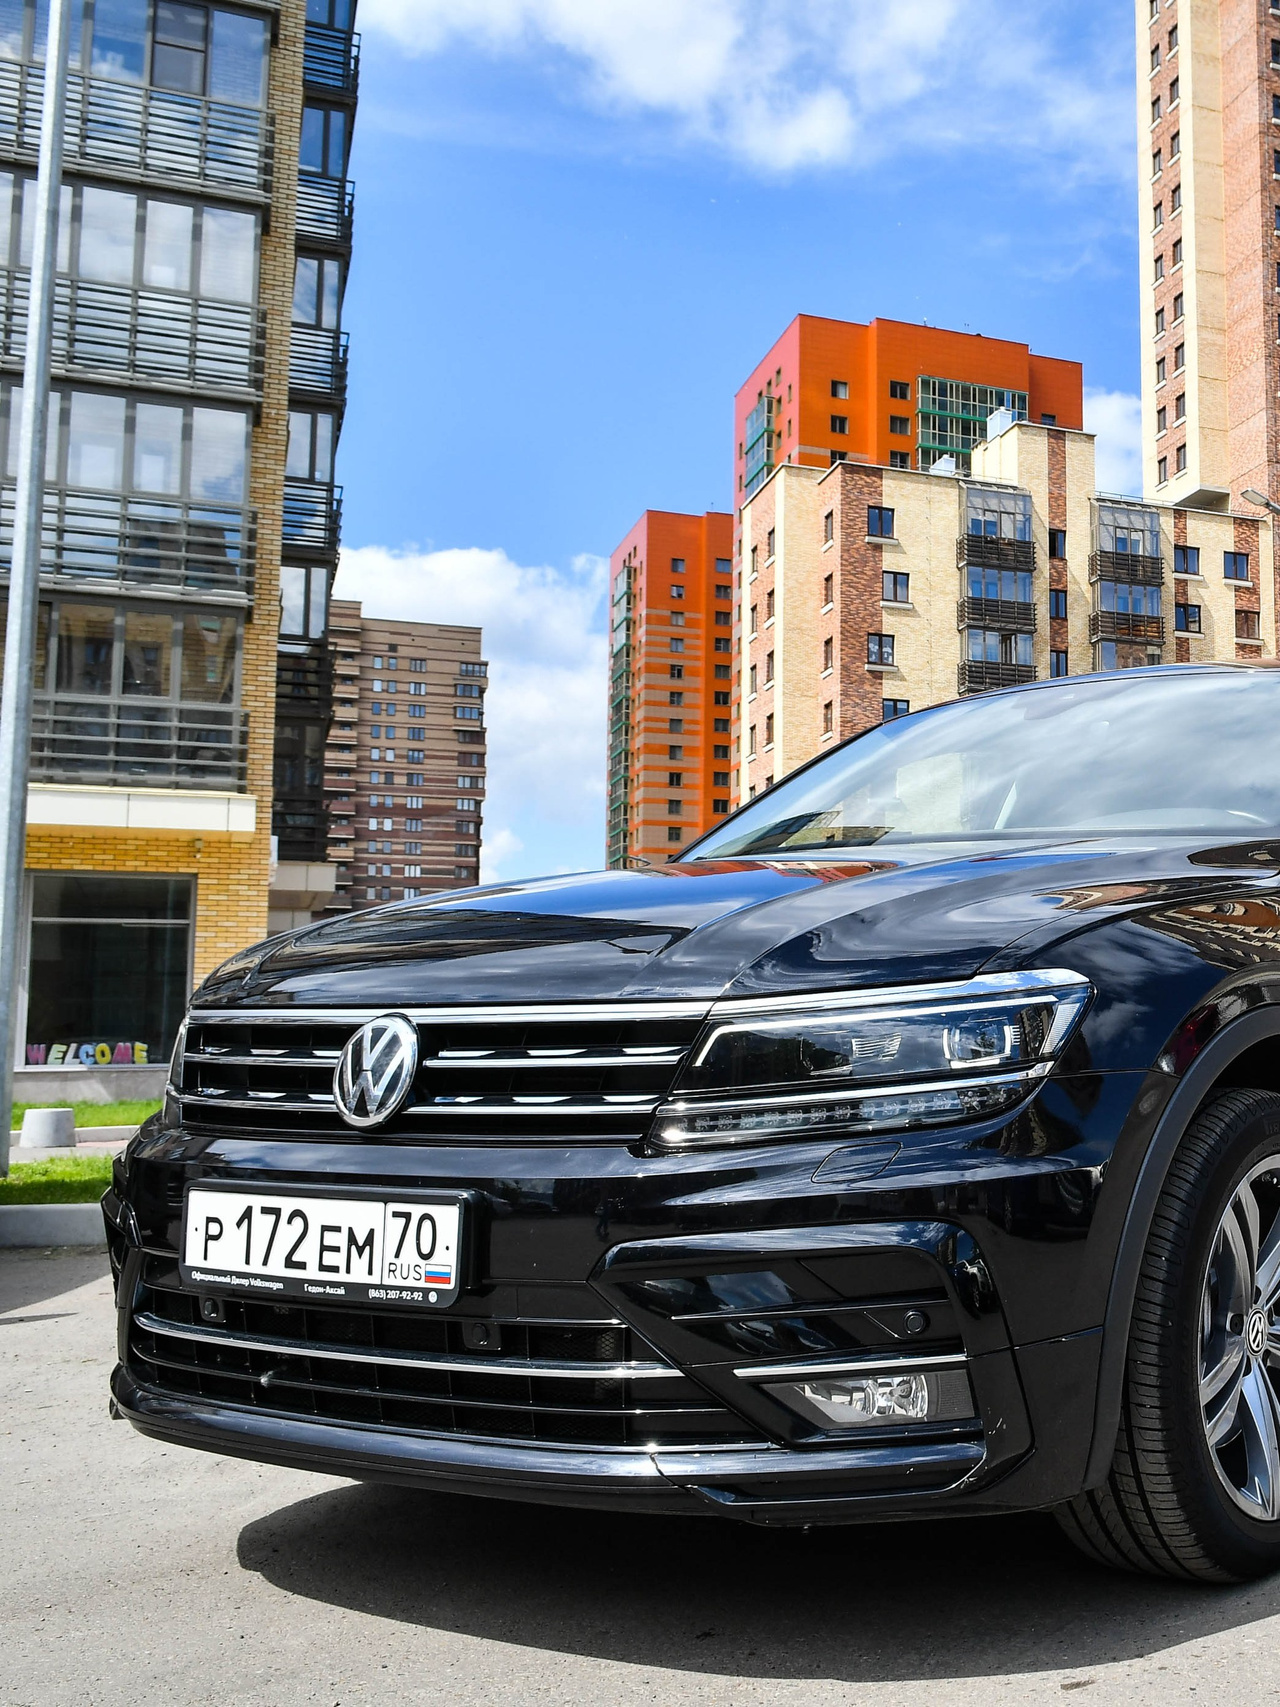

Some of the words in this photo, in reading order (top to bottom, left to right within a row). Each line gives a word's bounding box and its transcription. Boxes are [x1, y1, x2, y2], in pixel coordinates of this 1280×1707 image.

[26, 1041, 149, 1066] WELCOME
[391, 1211, 437, 1261] 70
[387, 1262, 422, 1282] RUS
[249, 1278, 284, 1290] Volkswagen
[304, 1283, 345, 1295] Гедон-Аксай
[368, 1288, 386, 1300] (863)
[386, 1290, 423, 1301] 207-92-92
